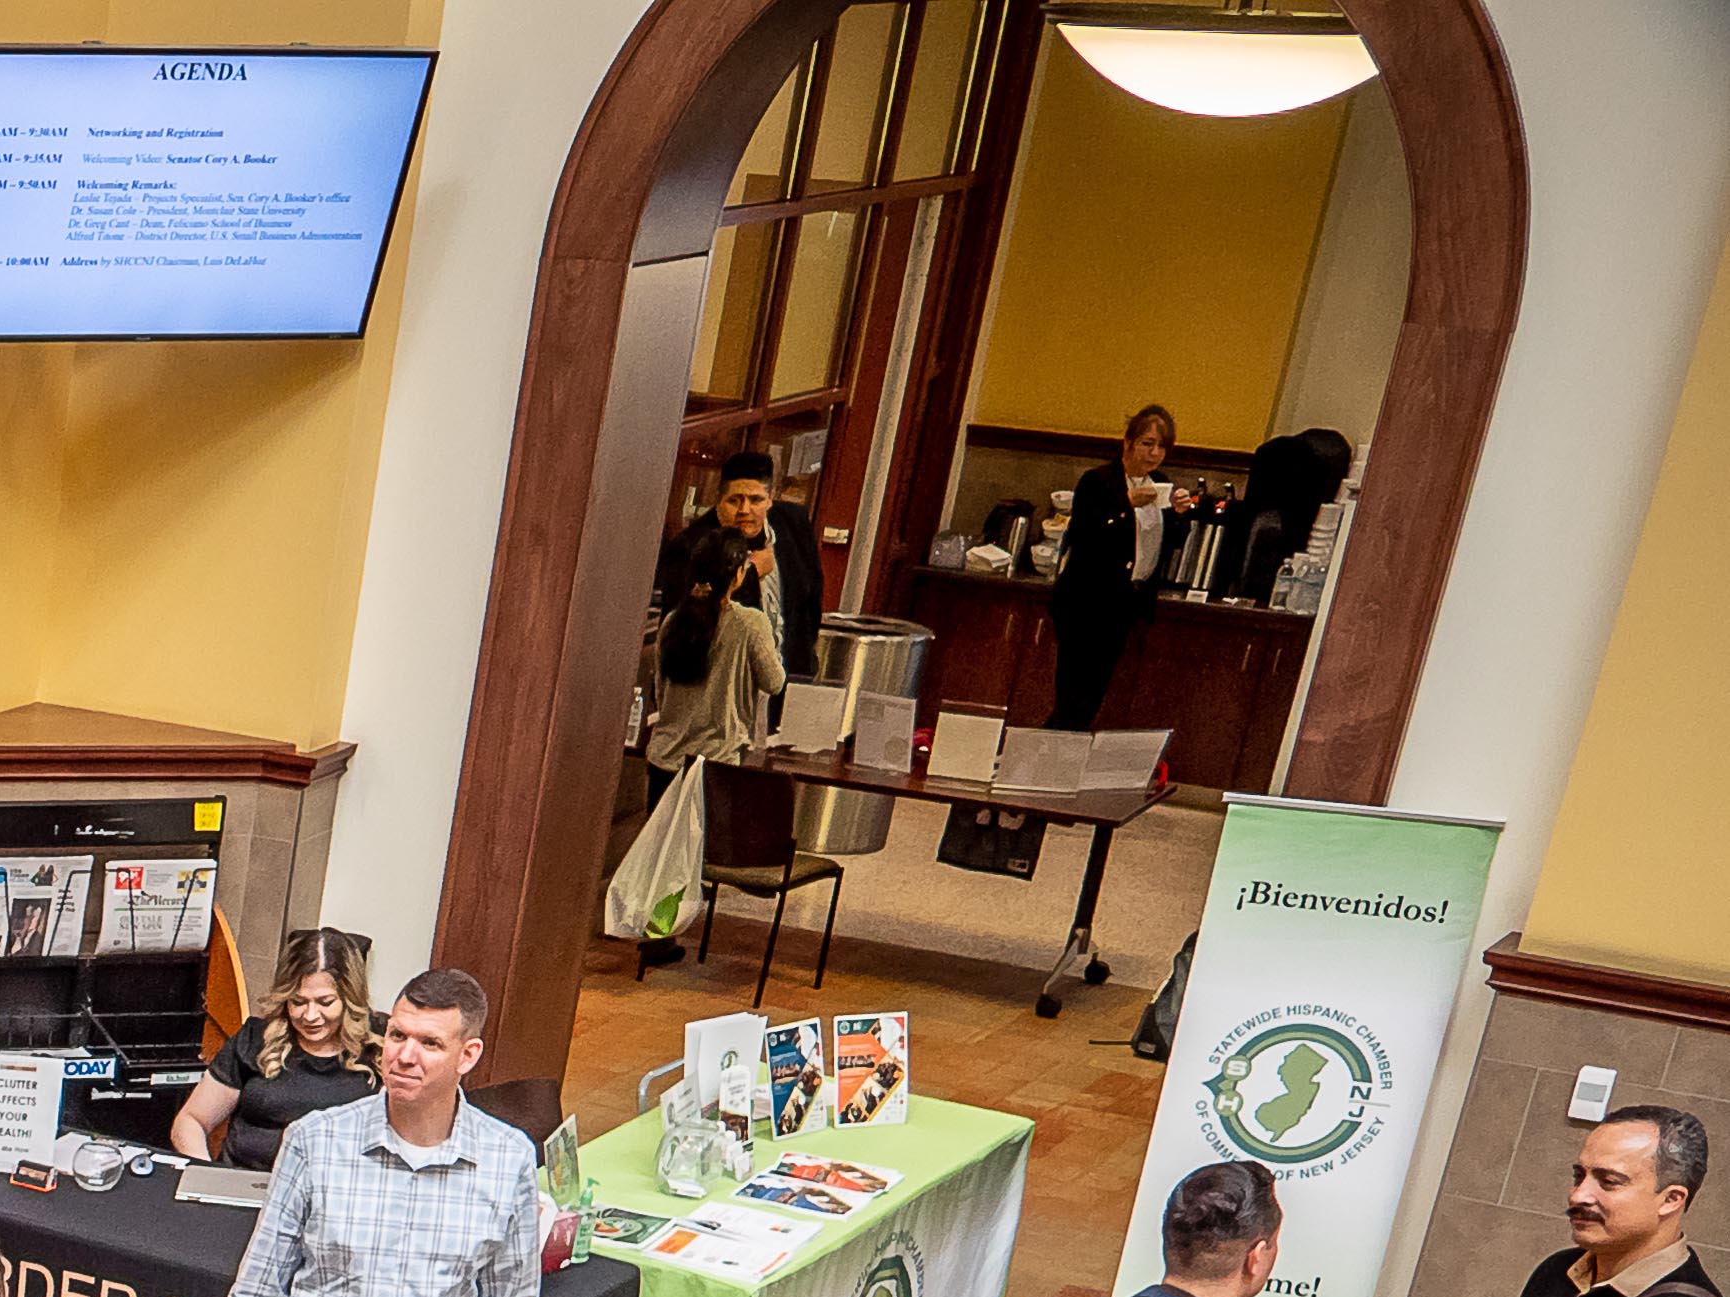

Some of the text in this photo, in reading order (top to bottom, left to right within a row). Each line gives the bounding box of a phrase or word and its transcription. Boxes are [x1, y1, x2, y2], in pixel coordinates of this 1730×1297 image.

[152, 61, 249, 82] AGENDA
[88, 128, 143, 139] Networking
[145, 128, 163, 138] and
[166, 128, 224, 139] Registration
[82, 153, 133, 165] Welcoming
[166, 154, 203, 164] Senator
[205, 154, 228, 166] Cory
[231, 154, 240, 164] A.
[243, 154, 277, 164] Booker
[77, 180, 129, 191] Welcoming
[131, 180, 176, 190] Remarks:
[248, 193, 272, 204] Cory
[70, 206, 85, 216] Dr.
[261, 206, 307, 218] University
[67, 219, 82, 229] Dr.
[211, 219, 241, 229] School
[242, 219, 254, 231] of
[254, 219, 293, 229] Business
[65, 231, 95, 242] Alfred
[258, 231, 297, 242] Business
[59, 256, 98, 267] Address
[100, 256, 112, 269] by
[1236, 879, 1449, 924] ¡Bienvenidos!
[1208, 1003, 1393, 1090] STATEWIDE HISPANIC CHAMBER
[64, 1060, 111, 1076] ODAY
[1195, 1099, 1210, 1119] OF
[1274, 1169, 1295, 1181] OF
[1299, 1160, 1335, 1179] NEW
[1340, 1116, 1386, 1166] JERSEY
